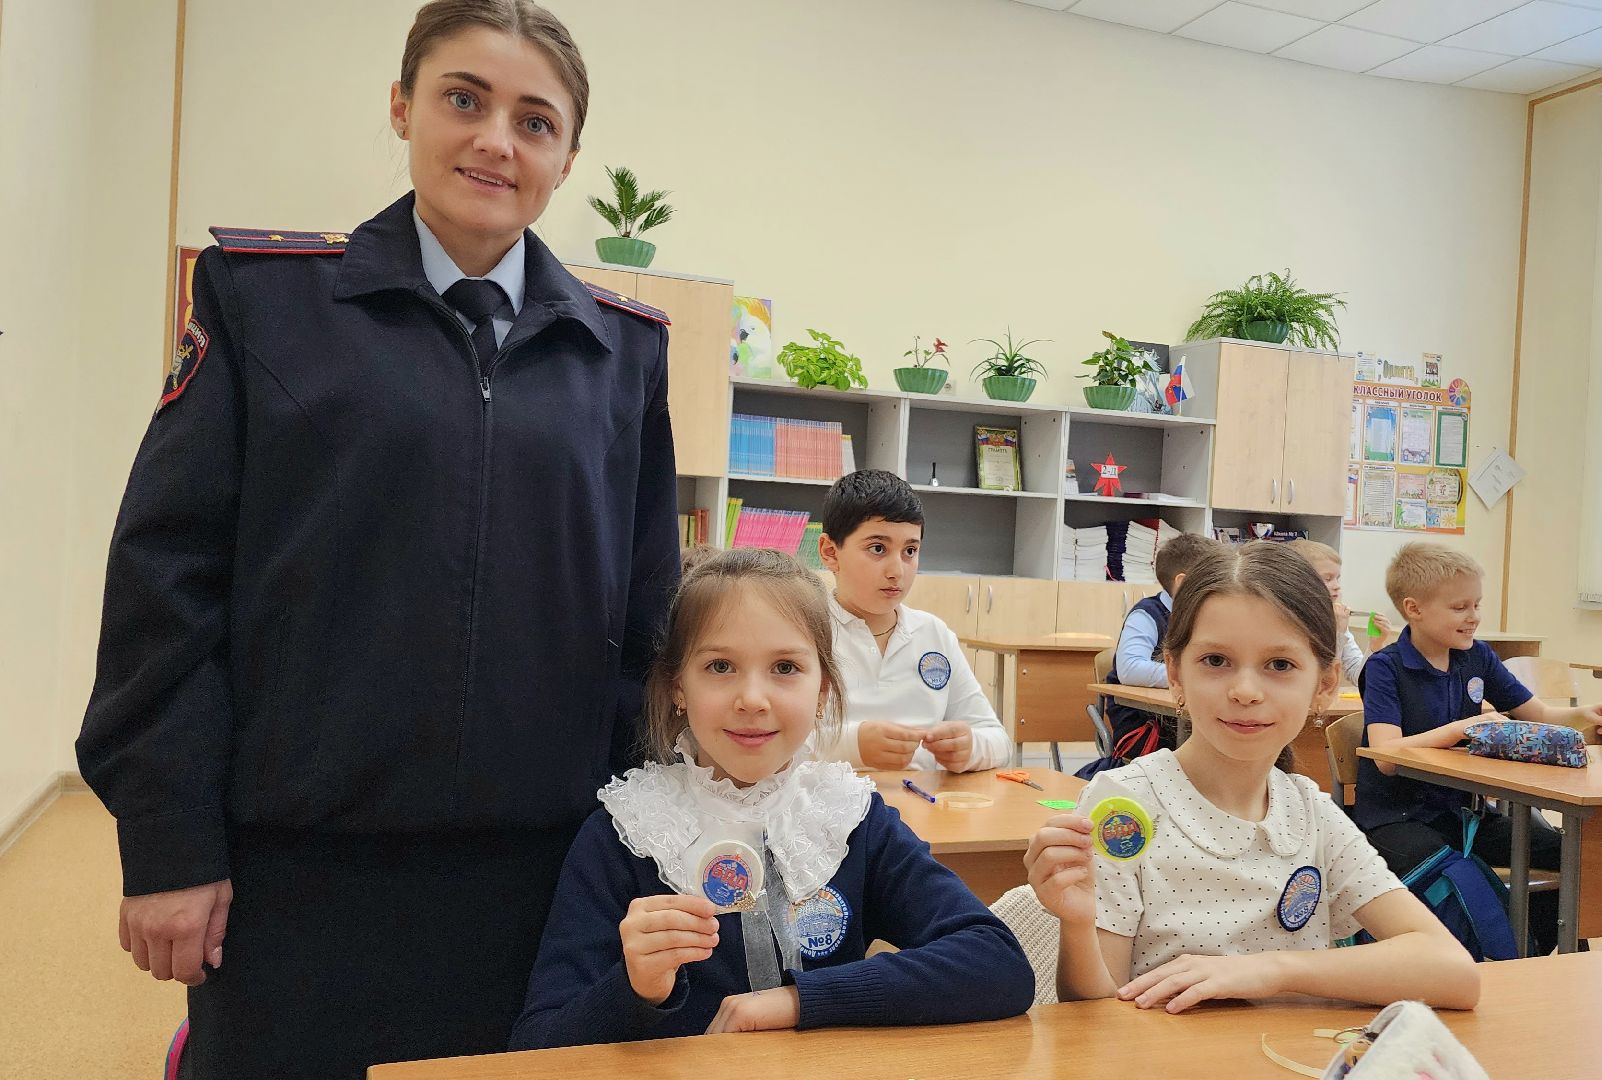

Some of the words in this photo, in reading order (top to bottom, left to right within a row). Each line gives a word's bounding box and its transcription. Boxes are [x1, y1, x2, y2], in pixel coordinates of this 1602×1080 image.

[1353, 385, 1404, 399] КЛАССНЫЙ
[1406, 390, 1442, 402] УГОЛОК
[808, 934, 833, 949] №8
